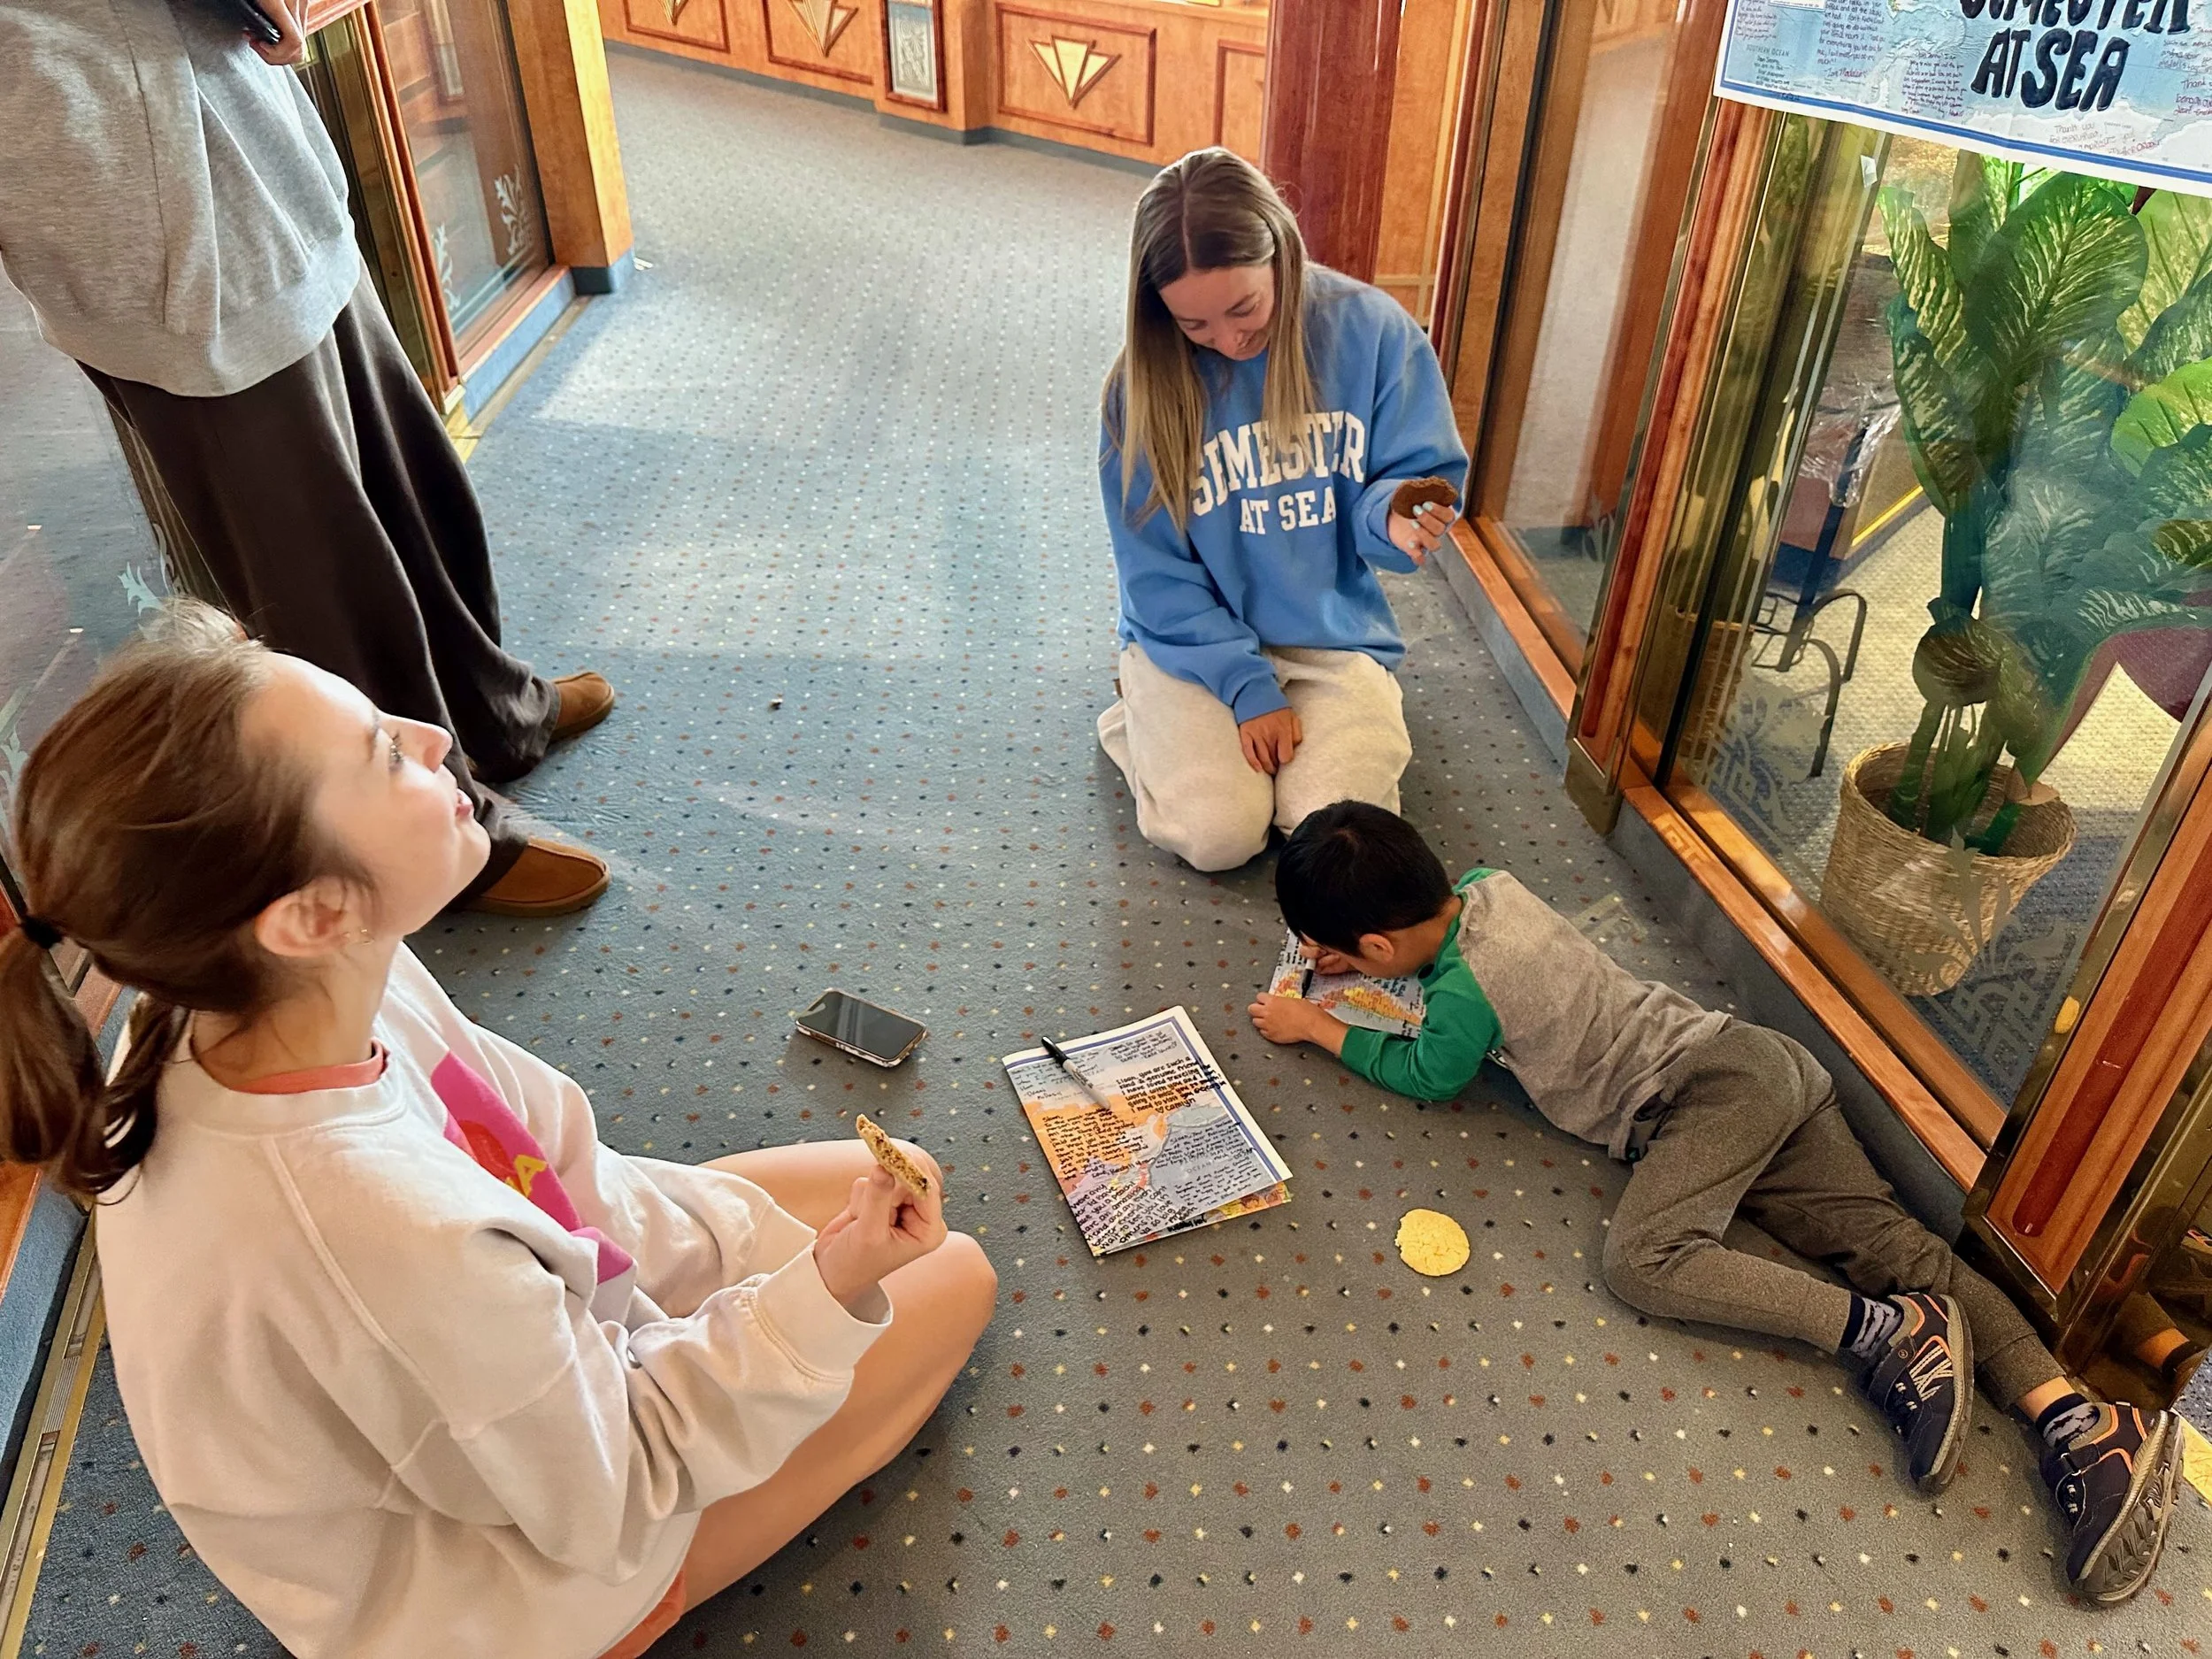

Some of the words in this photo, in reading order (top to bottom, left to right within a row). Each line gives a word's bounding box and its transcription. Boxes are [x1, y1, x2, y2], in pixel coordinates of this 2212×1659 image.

[1771, 48, 1789, 57] OCEAN
[2021, 28, 2131, 111] SEA
[1240, 498, 1270, 535] AT
[1278, 487, 1337, 532] SEA
[1165, 1058, 1184, 1068] such
[1119, 1080, 1135, 1089] kind
[1146, 1069, 1176, 1082] genuine
[1125, 1090, 1147, 1101] world
[1167, 1080, 1182, 1091] you
[1183, 1074, 1197, 1083] and
[1146, 1078, 1165, 1087] loved
[1127, 1097, 1148, 1107] going
[1157, 1089, 1173, 1098] miss
[1175, 1085, 1189, 1094] you
[1136, 1102, 1153, 1110] need
[1185, 1161, 1211, 1173] OCEAN
[1089, 1185, 1108, 1196] any
[1097, 1187, 1118, 1201] have
[1092, 1203, 1106, 1215] you
[1098, 1211, 1111, 1221] an
[1111, 1186, 1144, 1210] amazing
[1156, 1200, 1173, 1214] love
[1109, 1210, 1123, 1223] and
[1122, 1202, 1134, 1212] an
[1120, 1223, 1130, 1232] to
[1127, 1213, 1142, 1225] see
[1141, 1202, 1158, 1217] you
[1156, 1193, 1170, 1202] in
[1140, 1226, 1151, 1236] ya
[1160, 1208, 1176, 1220] big
